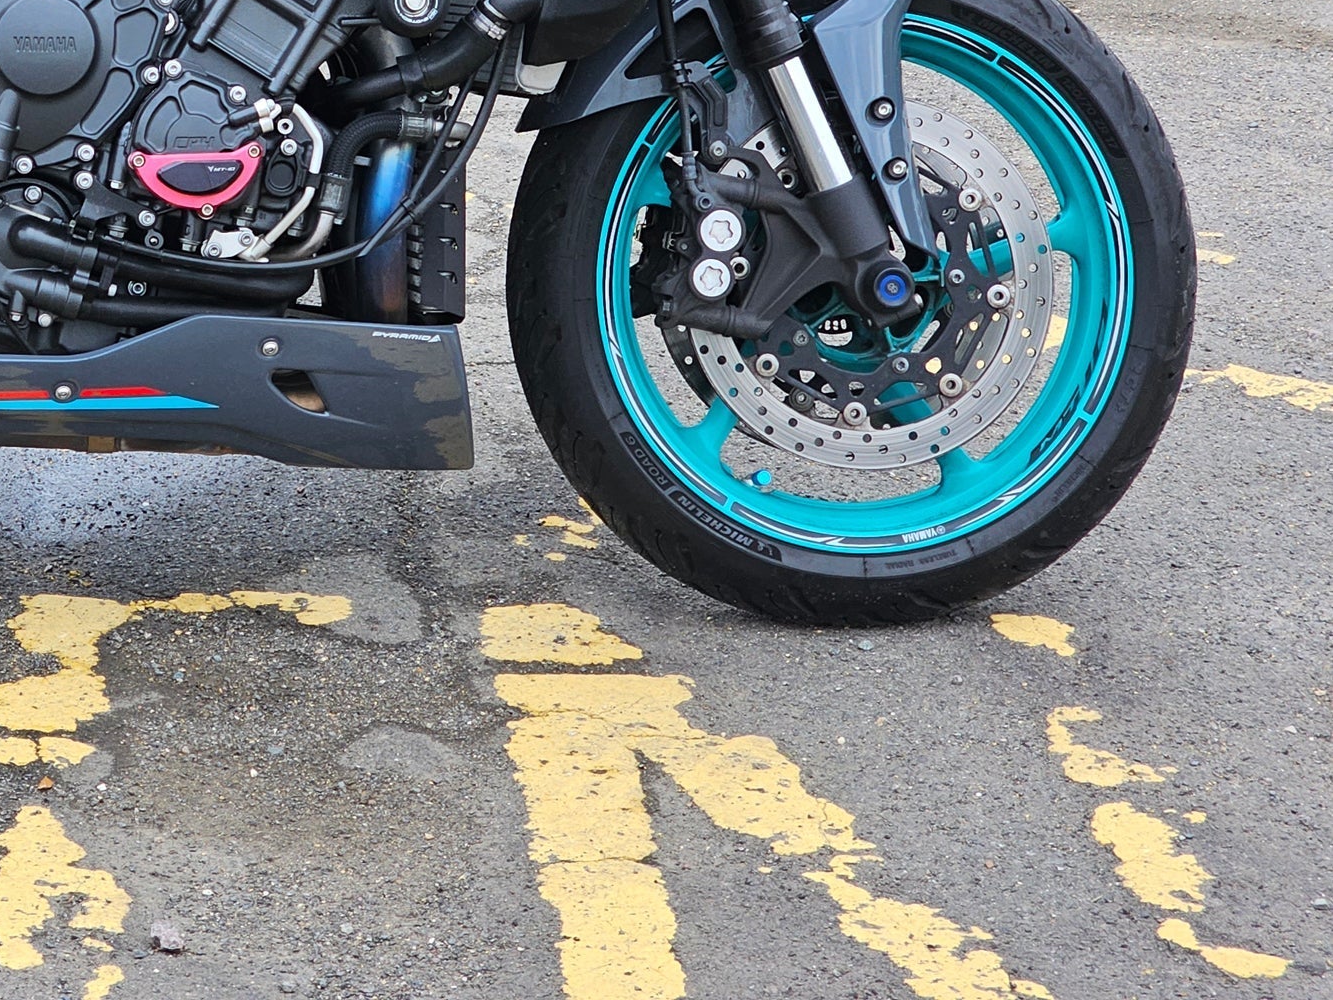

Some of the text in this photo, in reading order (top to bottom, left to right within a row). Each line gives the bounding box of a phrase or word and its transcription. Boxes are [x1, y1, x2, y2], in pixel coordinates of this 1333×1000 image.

[12, 35, 77, 53] YAMAHA
[634, 449, 669, 486] ROAD
[677, 495, 755, 547] MICHELIN
[901, 527, 938, 544] YAMAHA
